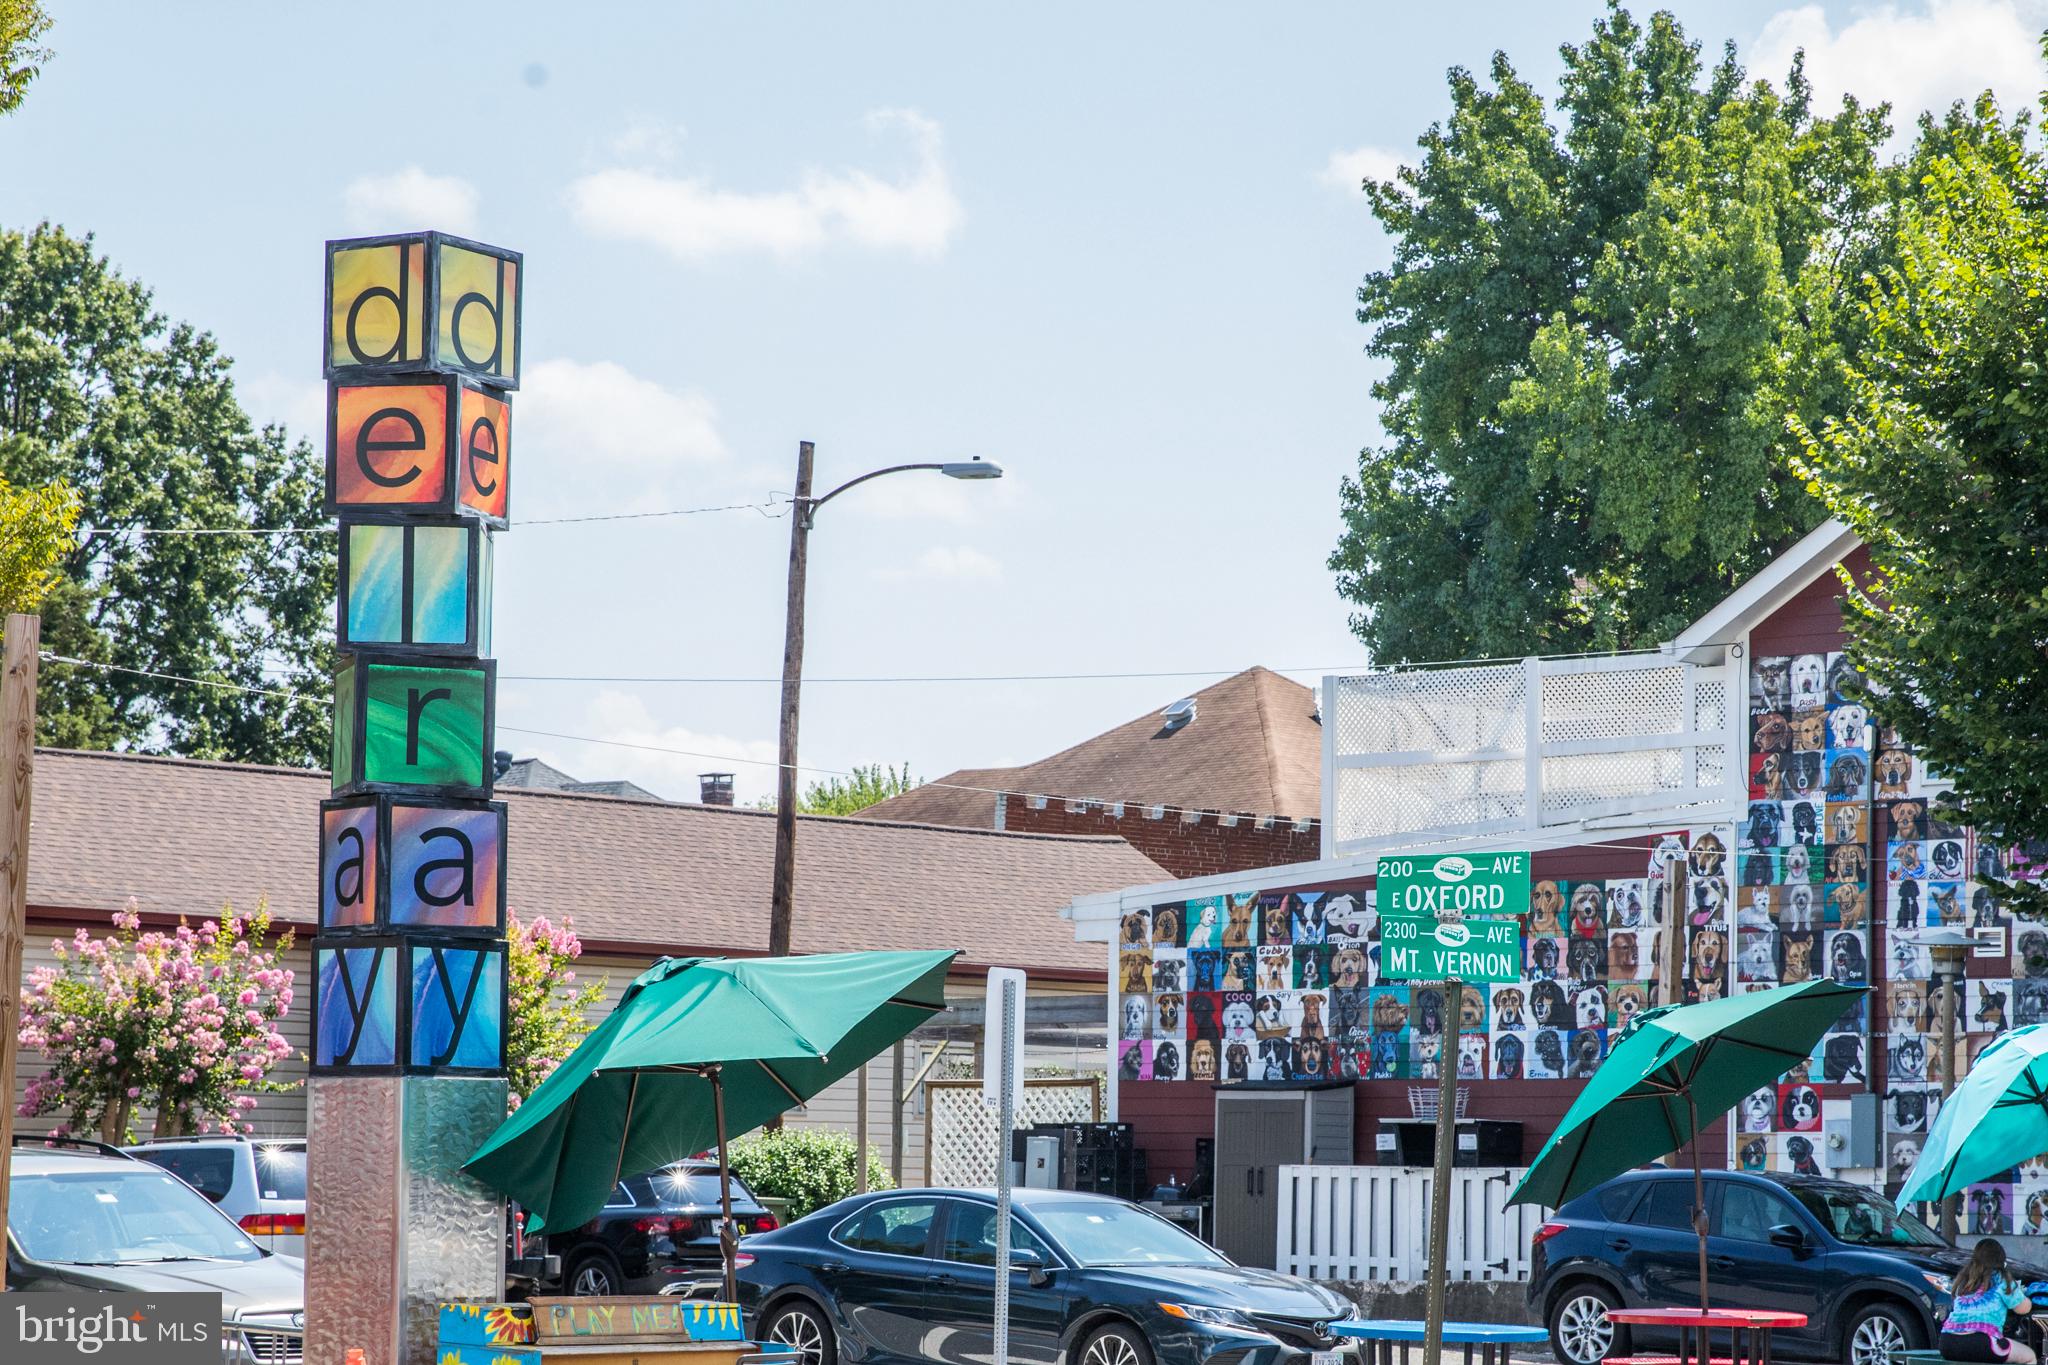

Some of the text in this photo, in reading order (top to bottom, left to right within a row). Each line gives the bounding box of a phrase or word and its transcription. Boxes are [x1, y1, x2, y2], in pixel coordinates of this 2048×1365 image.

[1814, 802, 1824, 845] NEPTUNE
[1378, 856, 1522, 878] 200 AVE
[1392, 885, 1504, 911] E OXFORD
[1384, 921, 1513, 944] 2300 AVE
[1703, 924, 1728, 932] TITUS
[1258, 946, 1291, 956] Cubby
[1337, 942, 1361, 951] Orion
[1391, 946, 1511, 977] MT. VERNON
[1225, 993, 1252, 1002] COCO
[1529, 1069, 1549, 1077] Ernie
[552, 1304, 679, 1336] PLAY ME!
